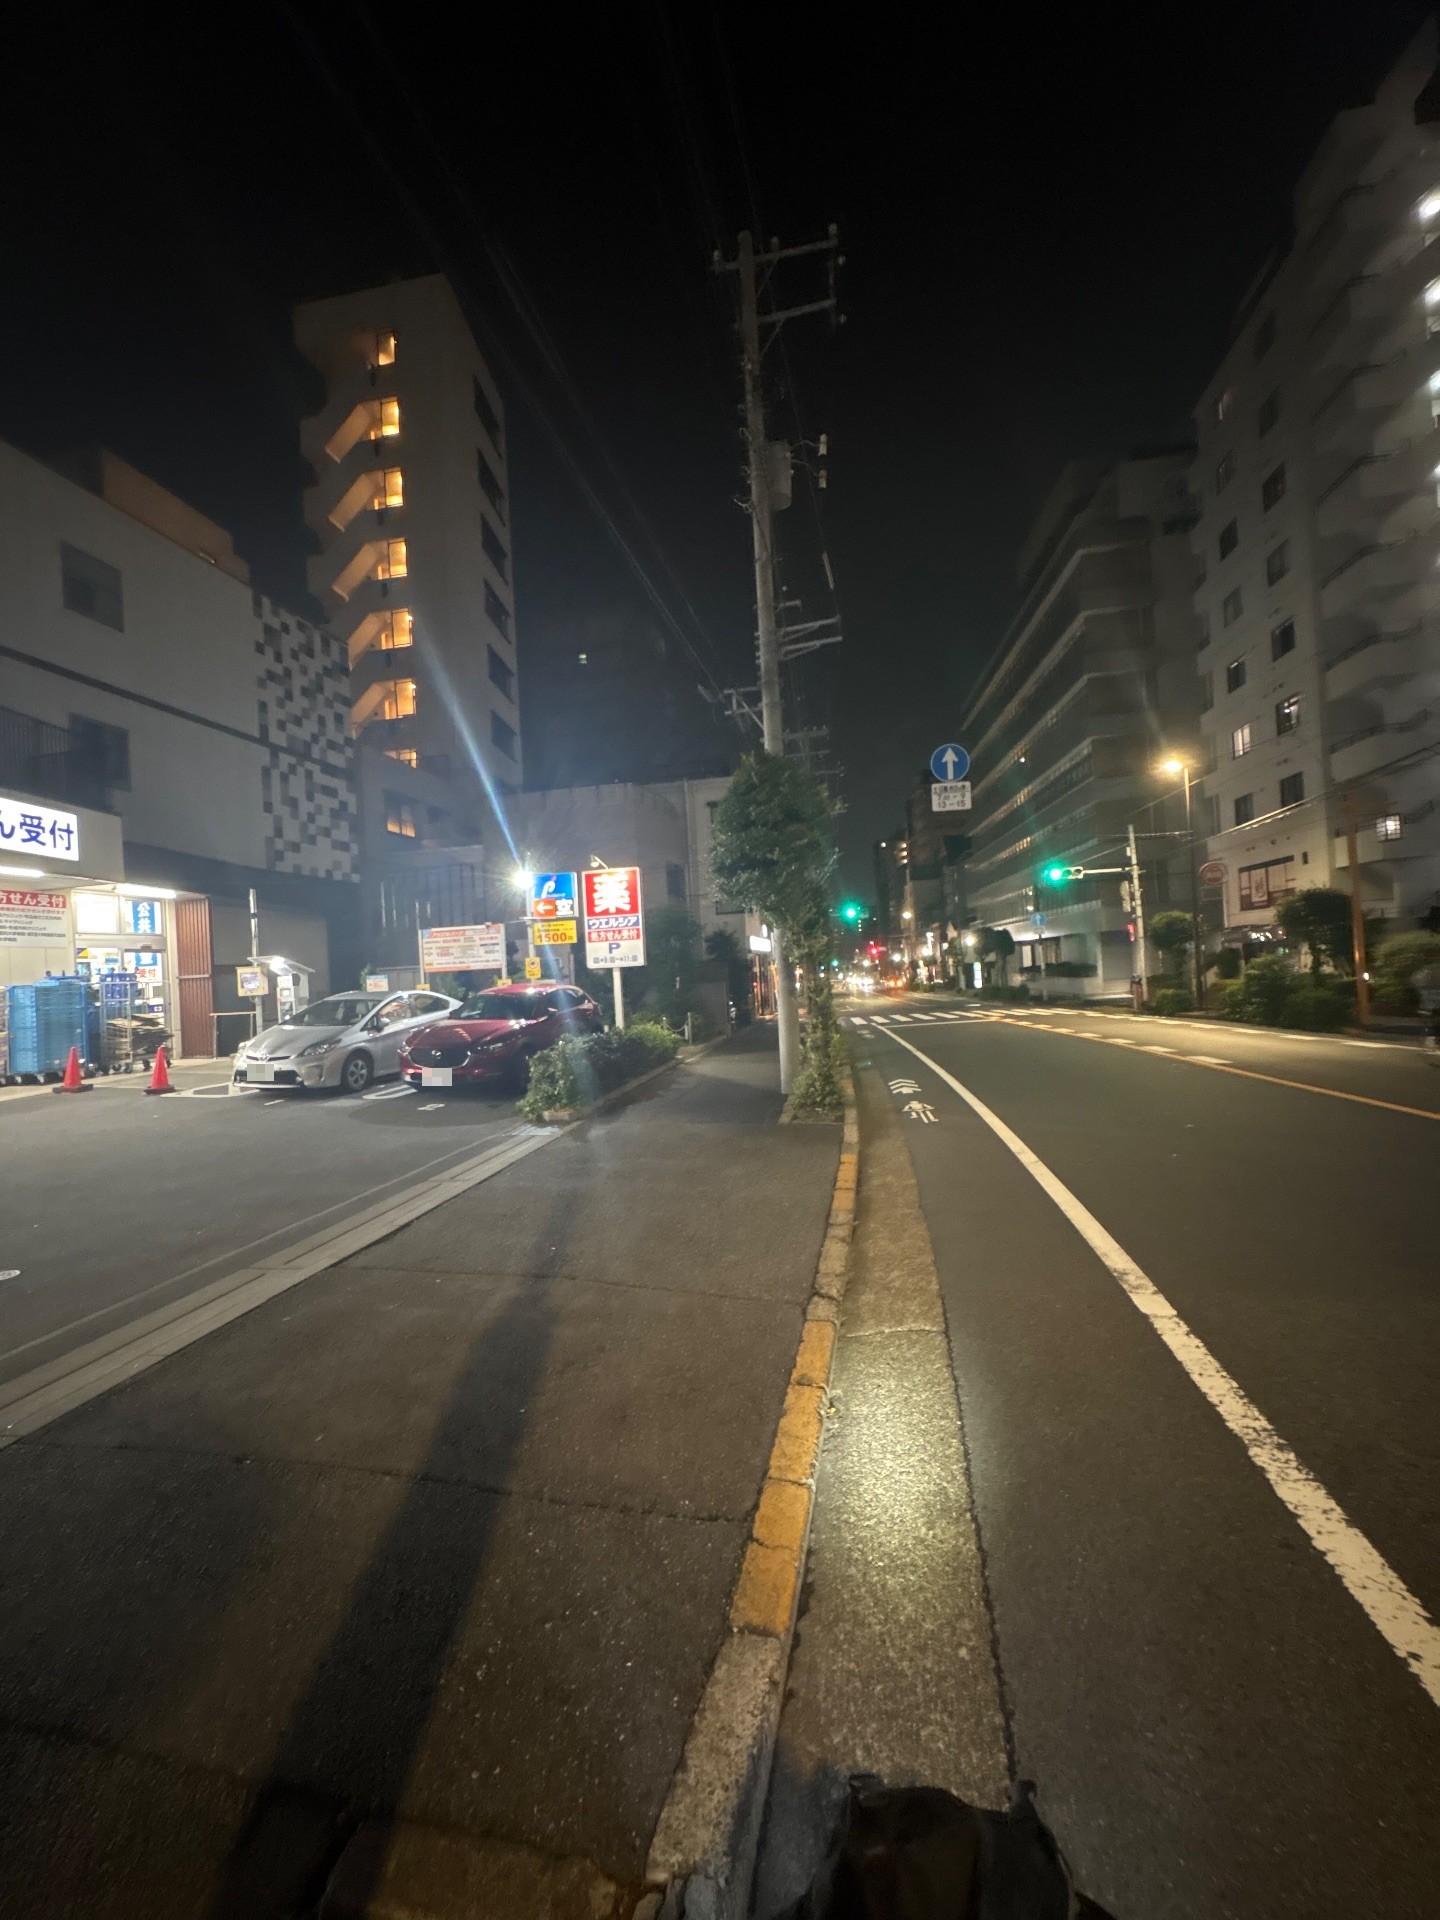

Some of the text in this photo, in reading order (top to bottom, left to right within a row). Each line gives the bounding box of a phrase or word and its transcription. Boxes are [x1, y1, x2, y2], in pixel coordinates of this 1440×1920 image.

[593, 870, 631, 913] 薬
[588, 916, 638, 930] ウエルシア
[536, 932, 574, 943] 1500円
[590, 929, 638, 942] 処方せん受付
[608, 943, 621, 954] P
